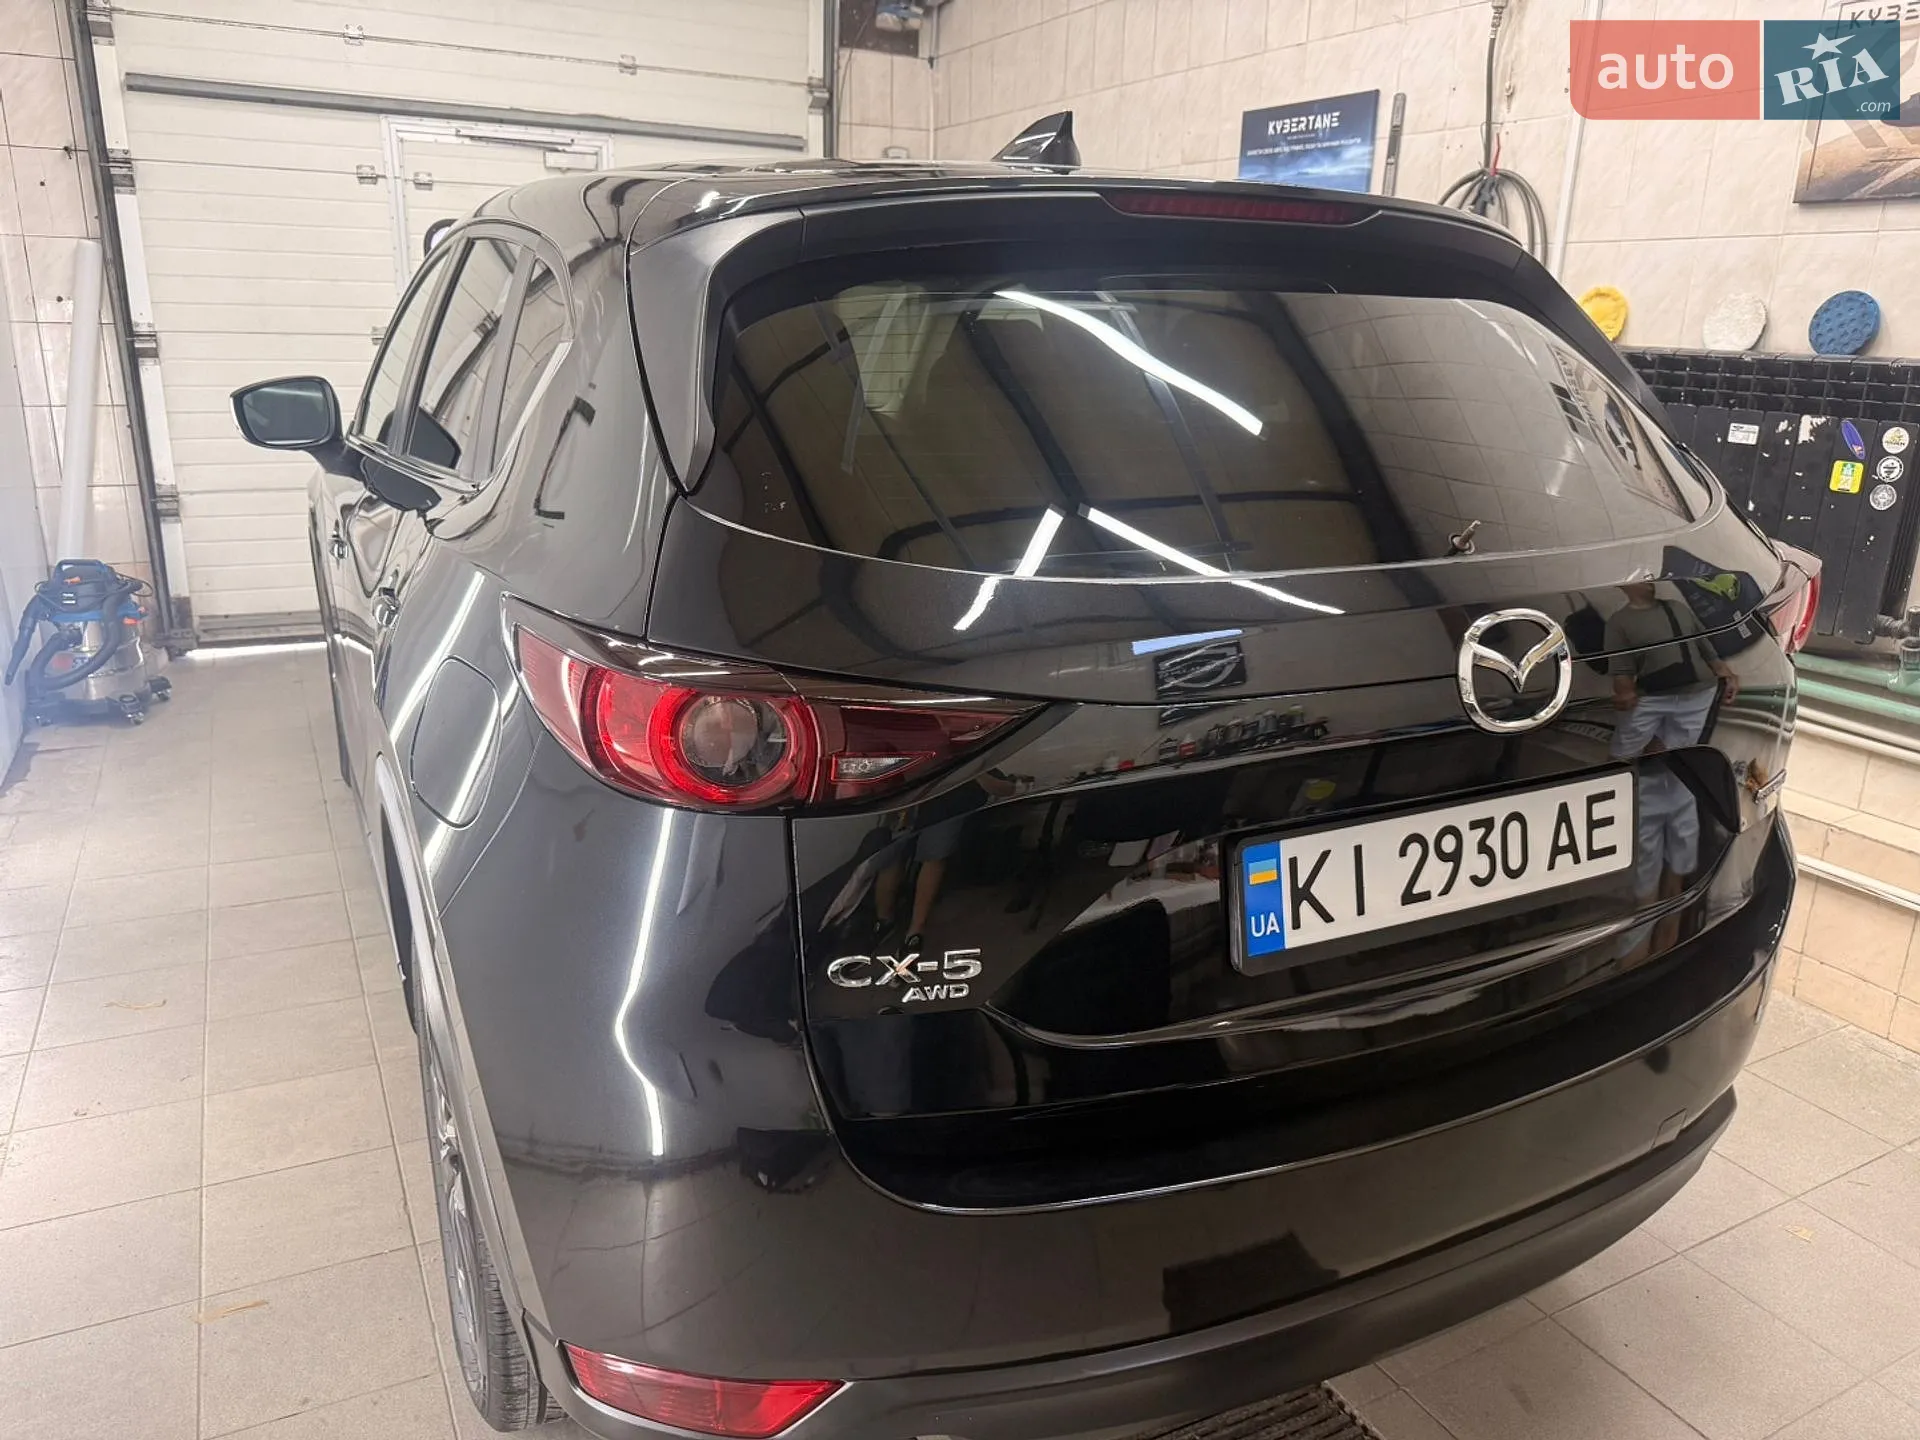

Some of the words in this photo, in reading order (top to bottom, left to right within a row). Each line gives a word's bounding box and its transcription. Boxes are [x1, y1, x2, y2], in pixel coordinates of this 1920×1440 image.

[1267, 110, 1341, 136] KYBERTANE
[1288, 843, 1366, 931] KI
[1398, 810, 1529, 906] 2930
[1546, 789, 1617, 871] AE
[1250, 911, 1280, 938] UA
[827, 948, 982, 988] CX-5
[902, 983, 970, 1003] AWD
